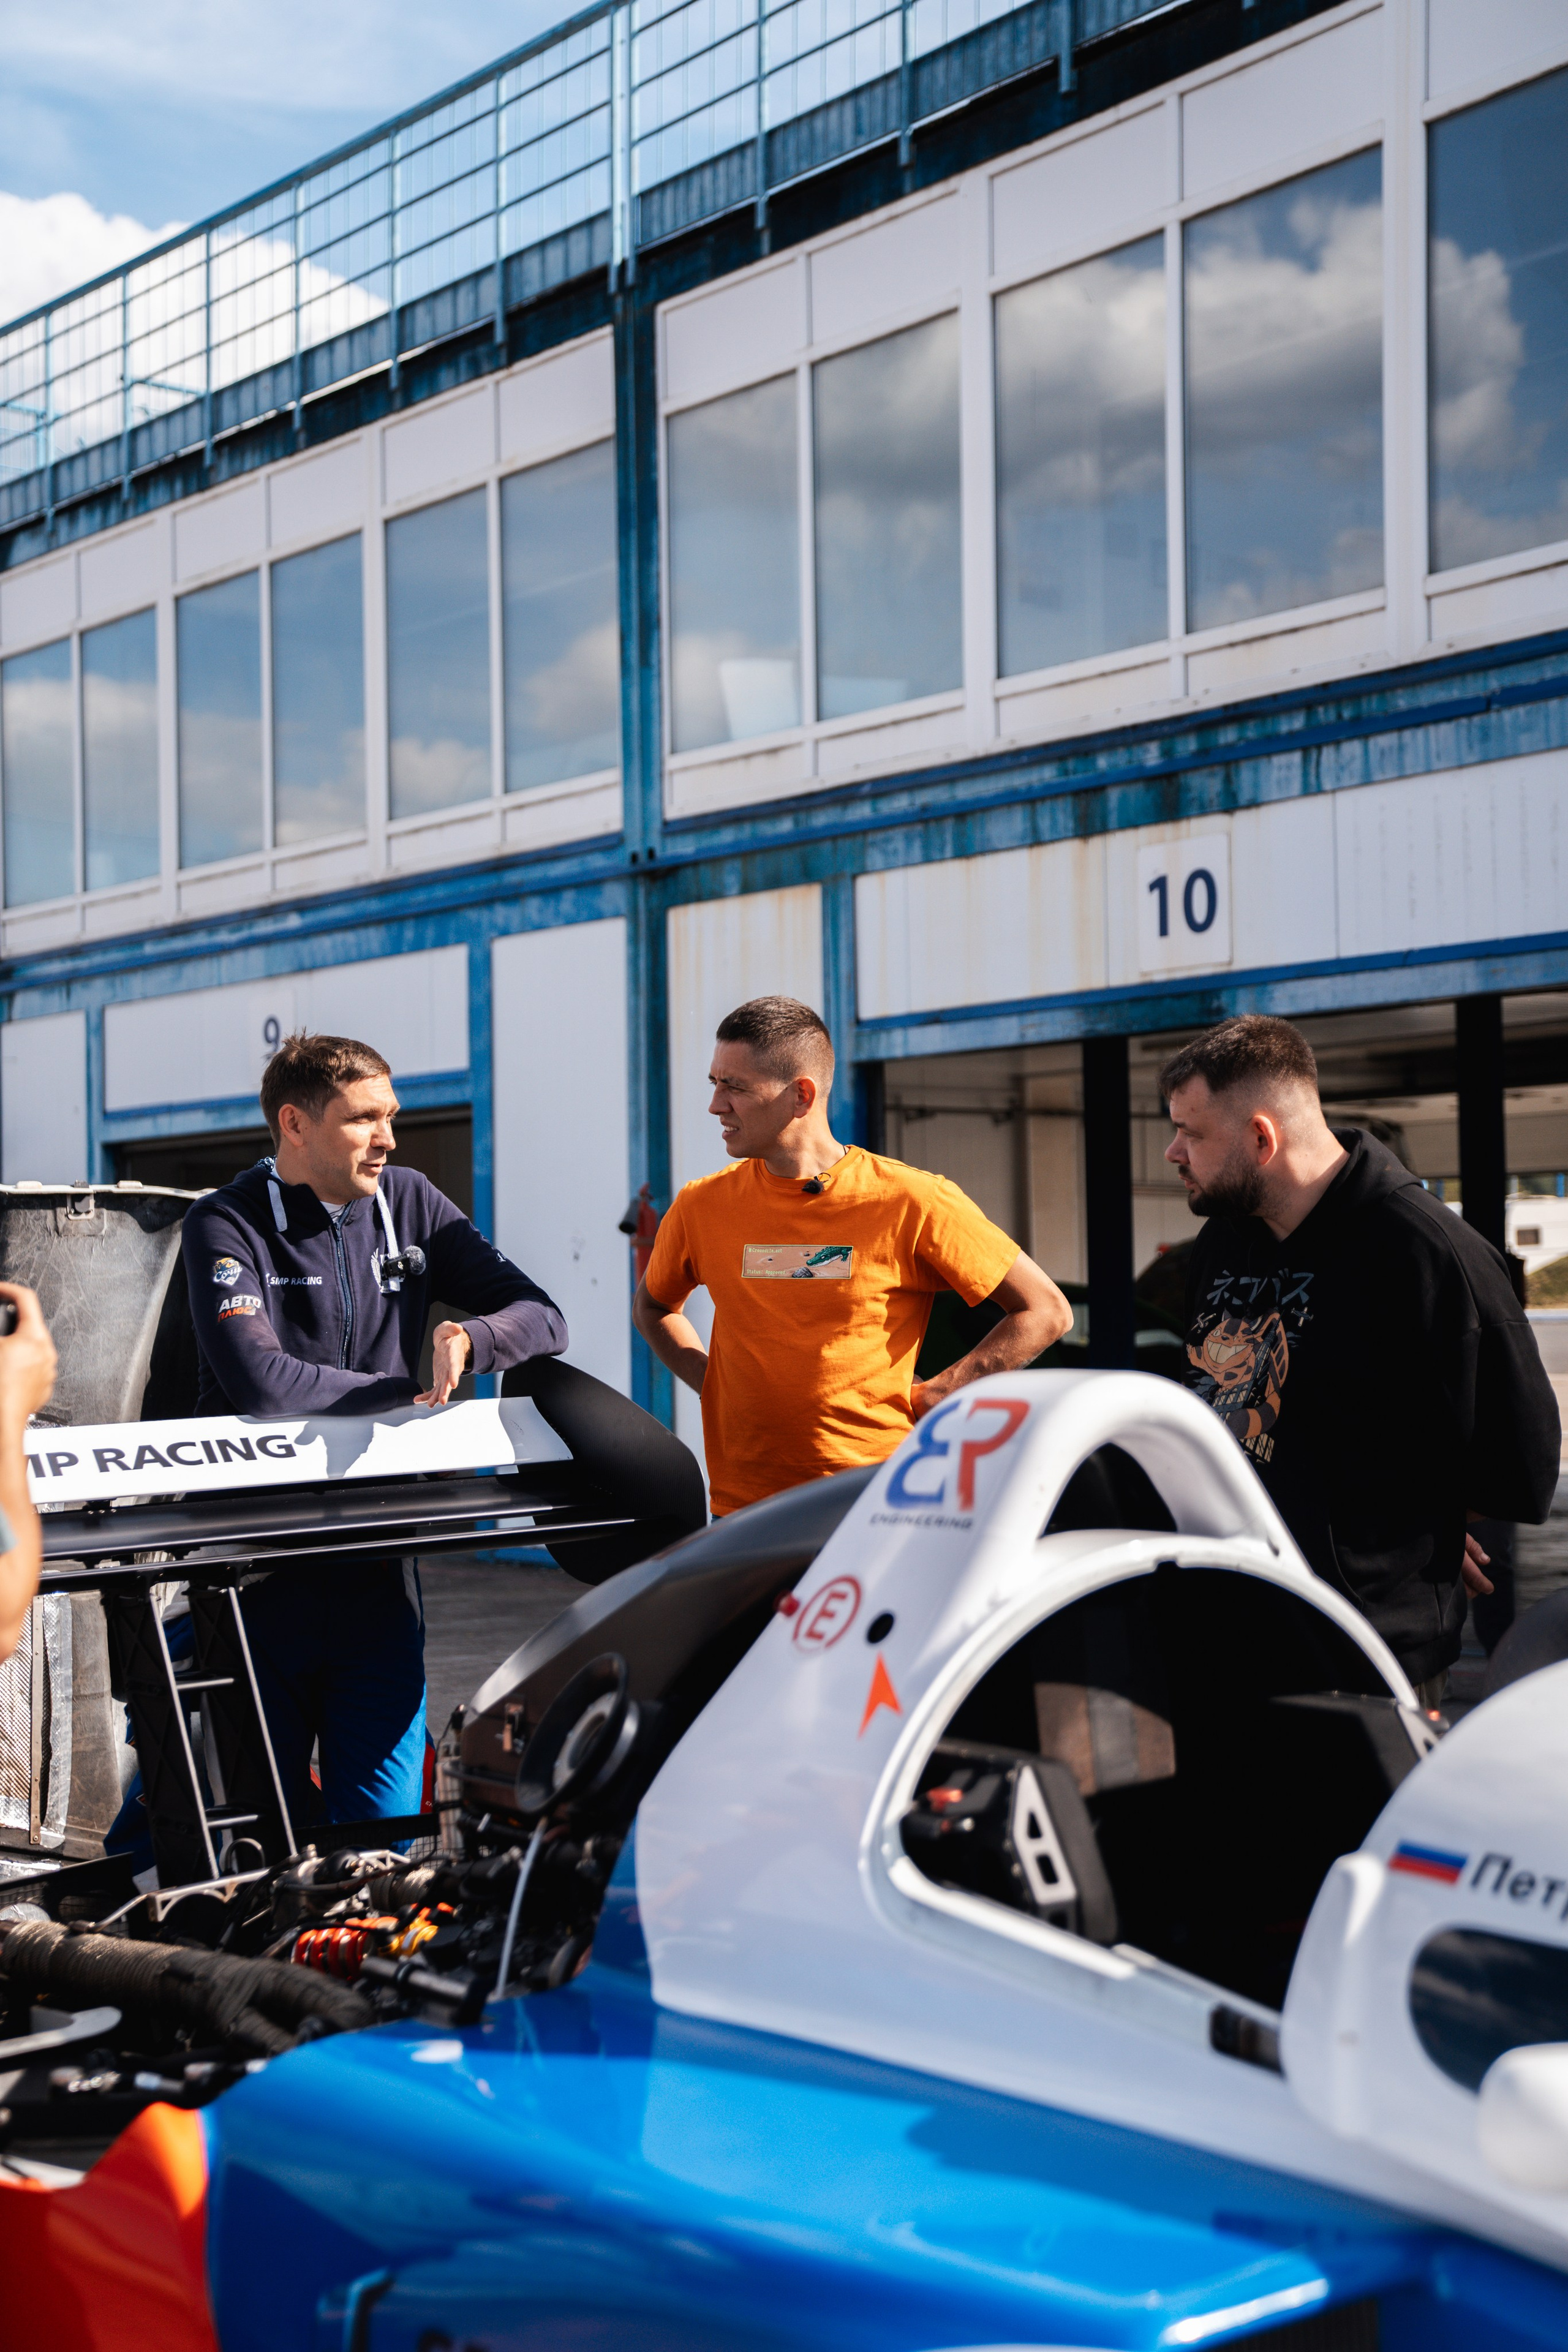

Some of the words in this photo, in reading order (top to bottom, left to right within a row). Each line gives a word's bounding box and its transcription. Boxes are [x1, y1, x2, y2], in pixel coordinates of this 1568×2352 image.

[1148, 868, 1218, 937] 10
[263, 1017, 280, 1052] 9
[270, 1276, 289, 1285] SMP
[291, 1276, 322, 1285] RACING
[218, 1295, 262, 1313] АВТО
[217, 1306, 252, 1322] ПЛЮС
[92, 1434, 297, 1473] RACING
[870, 1513, 974, 1529] ENGINEERING
